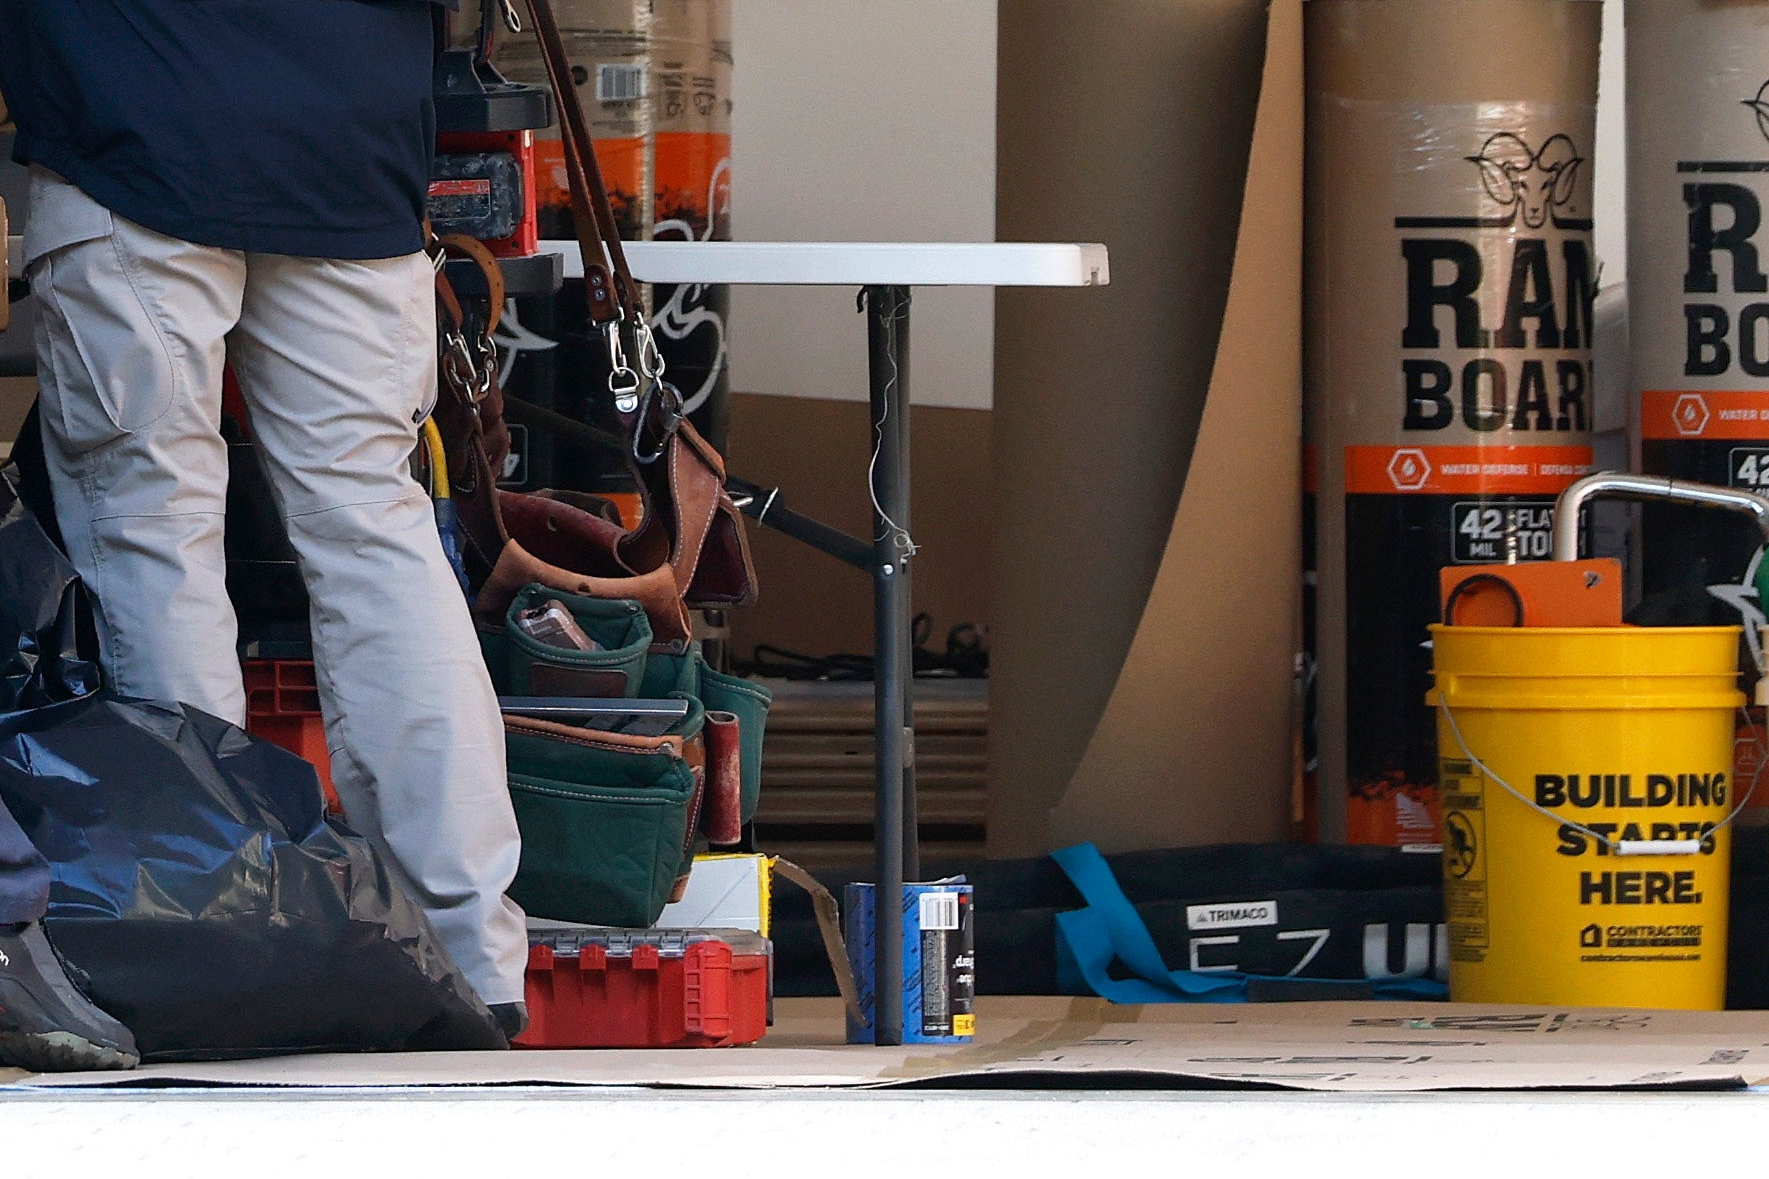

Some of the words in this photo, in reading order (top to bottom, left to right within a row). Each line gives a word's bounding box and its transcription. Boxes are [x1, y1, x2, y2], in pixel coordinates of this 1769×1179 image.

[1403, 359, 1593, 431] BOAR
[1459, 508, 1504, 540] 42
[1469, 542, 1497, 557] MIL
[1534, 773, 1727, 808] BUILDING
[1580, 870, 1703, 905] HERE.
[1209, 907, 1268, 922] TRIMACO
